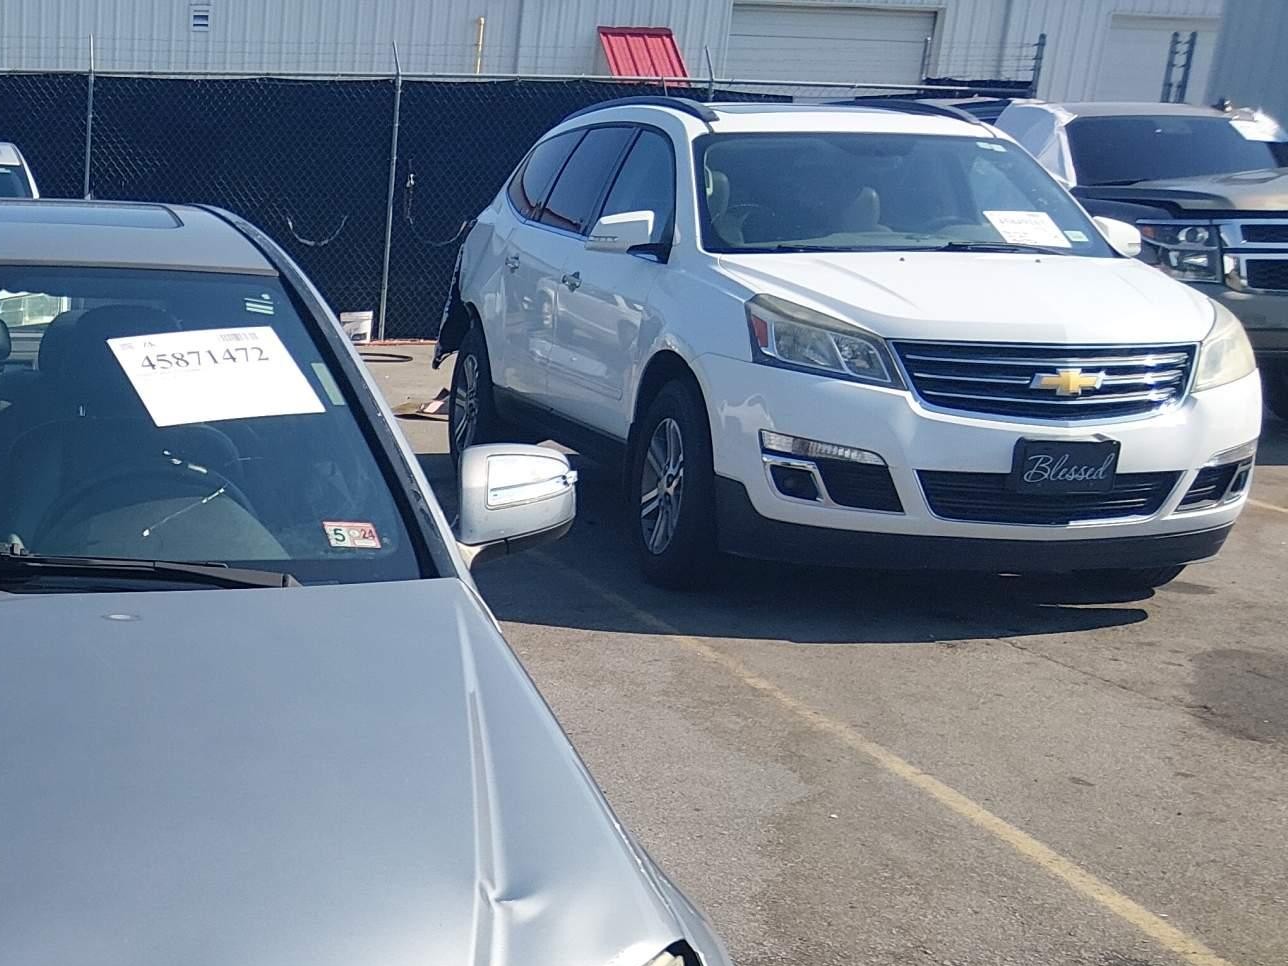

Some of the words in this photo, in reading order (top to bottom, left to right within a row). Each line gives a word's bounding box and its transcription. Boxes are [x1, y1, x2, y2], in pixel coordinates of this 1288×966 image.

[141, 346, 270, 370] 45871472
[1023, 452, 1116, 483] Blessed
[333, 528, 346, 542] 5
